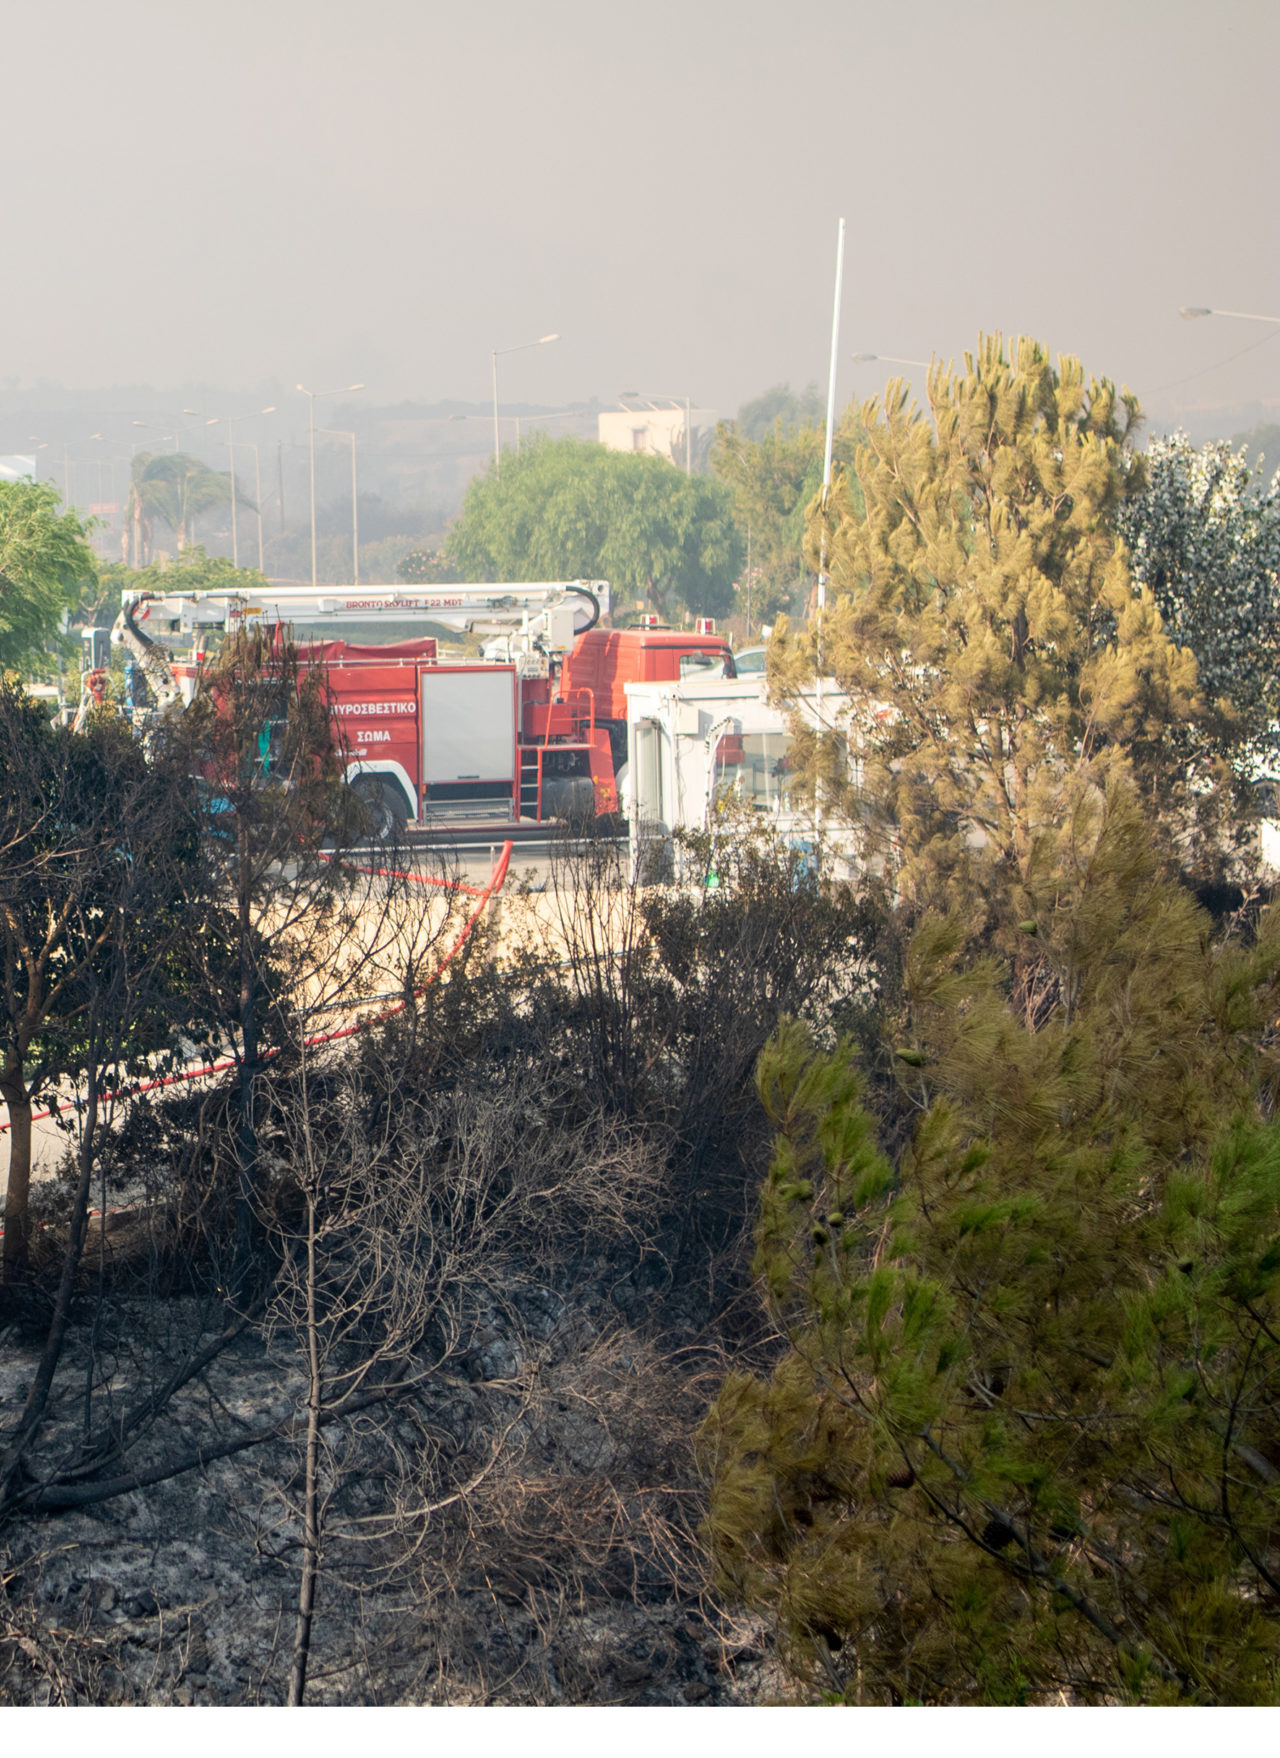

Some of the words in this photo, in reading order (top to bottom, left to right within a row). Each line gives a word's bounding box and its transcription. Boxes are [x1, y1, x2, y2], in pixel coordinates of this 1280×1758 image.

[345, 600, 382, 609] BRONTO
[384, 599, 419, 608] SKYLIFT
[430, 599, 441, 607] 22
[443, 598, 463, 607] MDT
[356, 730, 391, 743] ΣΩΜΑ
